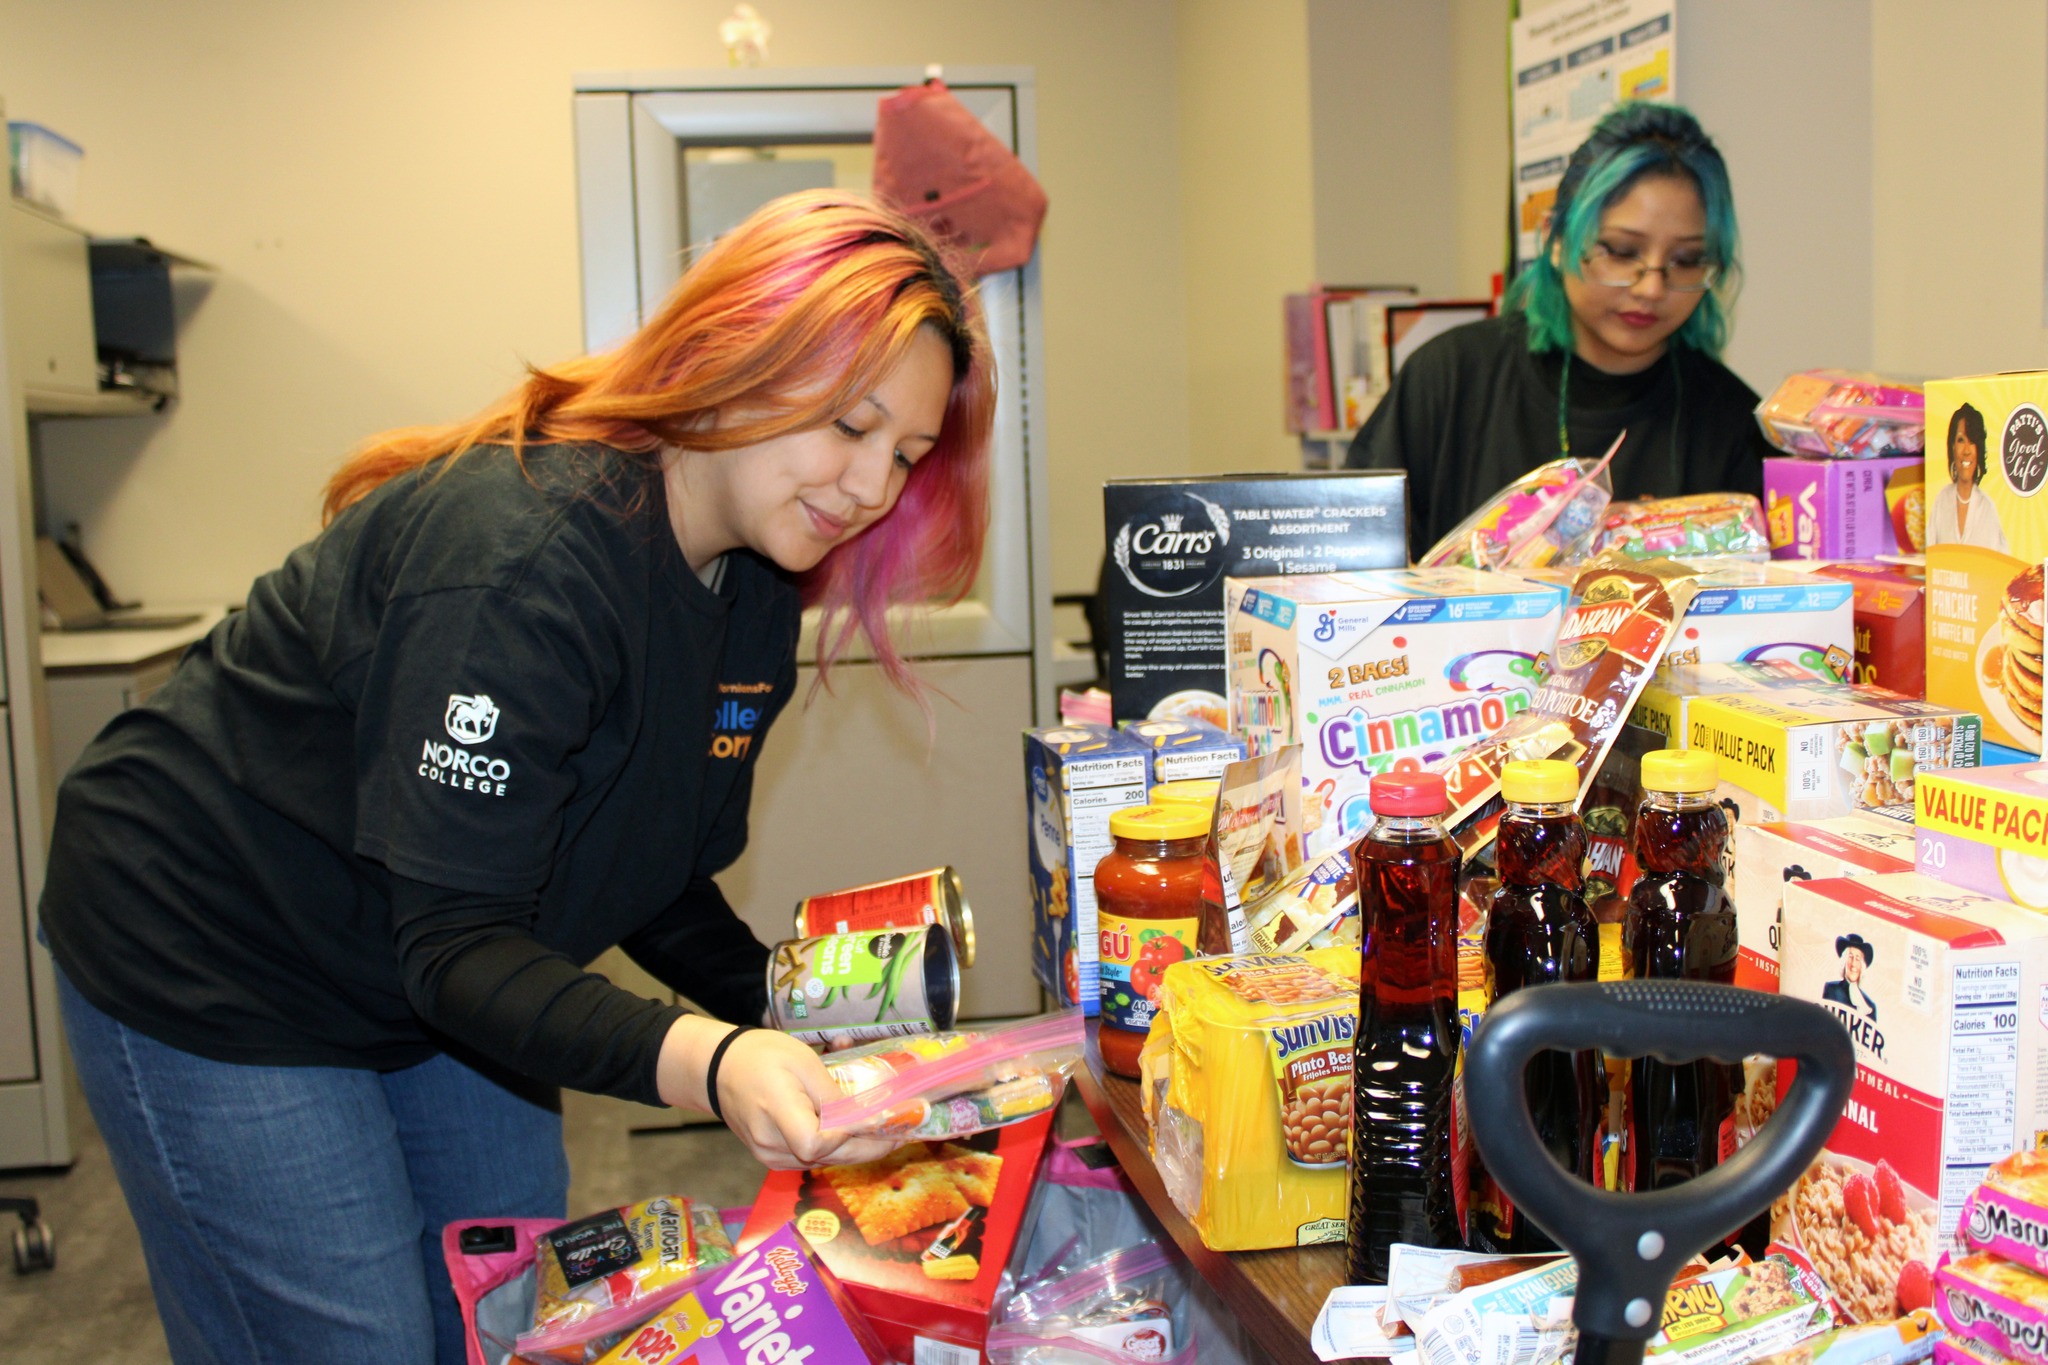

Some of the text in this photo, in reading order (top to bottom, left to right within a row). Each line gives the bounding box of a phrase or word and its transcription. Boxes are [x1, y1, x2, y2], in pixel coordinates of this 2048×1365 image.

[1233, 509, 1270, 520] TABLE
[1322, 506, 1386, 518] CRACKERS
[1269, 522, 1350, 536] ASSORTMENT
[1242, 547, 1251, 560] 3
[1253, 545, 1304, 561] Original
[1314, 546, 1322, 558] 2
[1162, 560, 1184, 570] 1831
[1278, 562, 1337, 574] 1 Sesame
[1932, 568, 1968, 590] BUTTERMILK
[1516, 601, 1528, 614] 12
[1808, 593, 1820, 608] 12
[1932, 589, 1978, 622] PANCAKE
[1937, 623, 1961, 643] WAFFLE
[1963, 628, 1976, 645] MIX
[1328, 655, 1410, 689] 2 BAGS!
[1349, 689, 1374, 701] REAL
[1375, 678, 1426, 696] CINNAMON
[1328, 689, 1529, 760] Cinnamon
[1650, 707, 1673, 739] PACK
[1694, 722, 1776, 774] 20 VALUE PACK
[1800, 741, 1808, 752] NO
[1954, 725, 1964, 752] PACKETS
[423, 738, 510, 782] NORCO
[1071, 759, 1143, 774] Nutrition Facts
[1166, 752, 1238, 764] Nutrition Facts
[418, 762, 508, 797] COLLEGE
[1802, 770, 1810, 790] 100%
[1074, 790, 1144, 805] Calories 200
[1922, 784, 1986, 830] VALUE
[1922, 838, 1946, 868] 20
[855, 939, 868, 954] Cut
[1100, 924, 1131, 960] GÚ
[1253, 932, 1272, 954] IDAHO
[1912, 944, 1928, 959] 100%
[1104, 965, 1120, 978] Style
[1203, 955, 1308, 976] SunVista
[1956, 966, 2017, 979] Nutrition Facts
[1914, 976, 1922, 987] NO
[1988, 991, 2004, 999] packet
[1824, 1003, 1885, 1060] UAKER
[1954, 1014, 2016, 1030] Calories 100
[1271, 1012, 1358, 1060] SunVist
[1291, 1053, 1325, 1078] Pinto
[1303, 1069, 1330, 1082] Frijoles
[1855, 1067, 1900, 1100] TMEAL
[644, 1222, 655, 1250] Ramen
[1305, 1221, 1330, 1232] GREAT
[1988, 1204, 2048, 1248] Maru
[555, 1229, 597, 1248] WORLD
[566, 1236, 626, 1261] Smile
[765, 1246, 808, 1296] Kellogg's
[1660, 1281, 1724, 1328] hewy
[1683, 1334, 1746, 1360] Nutrition Facts
